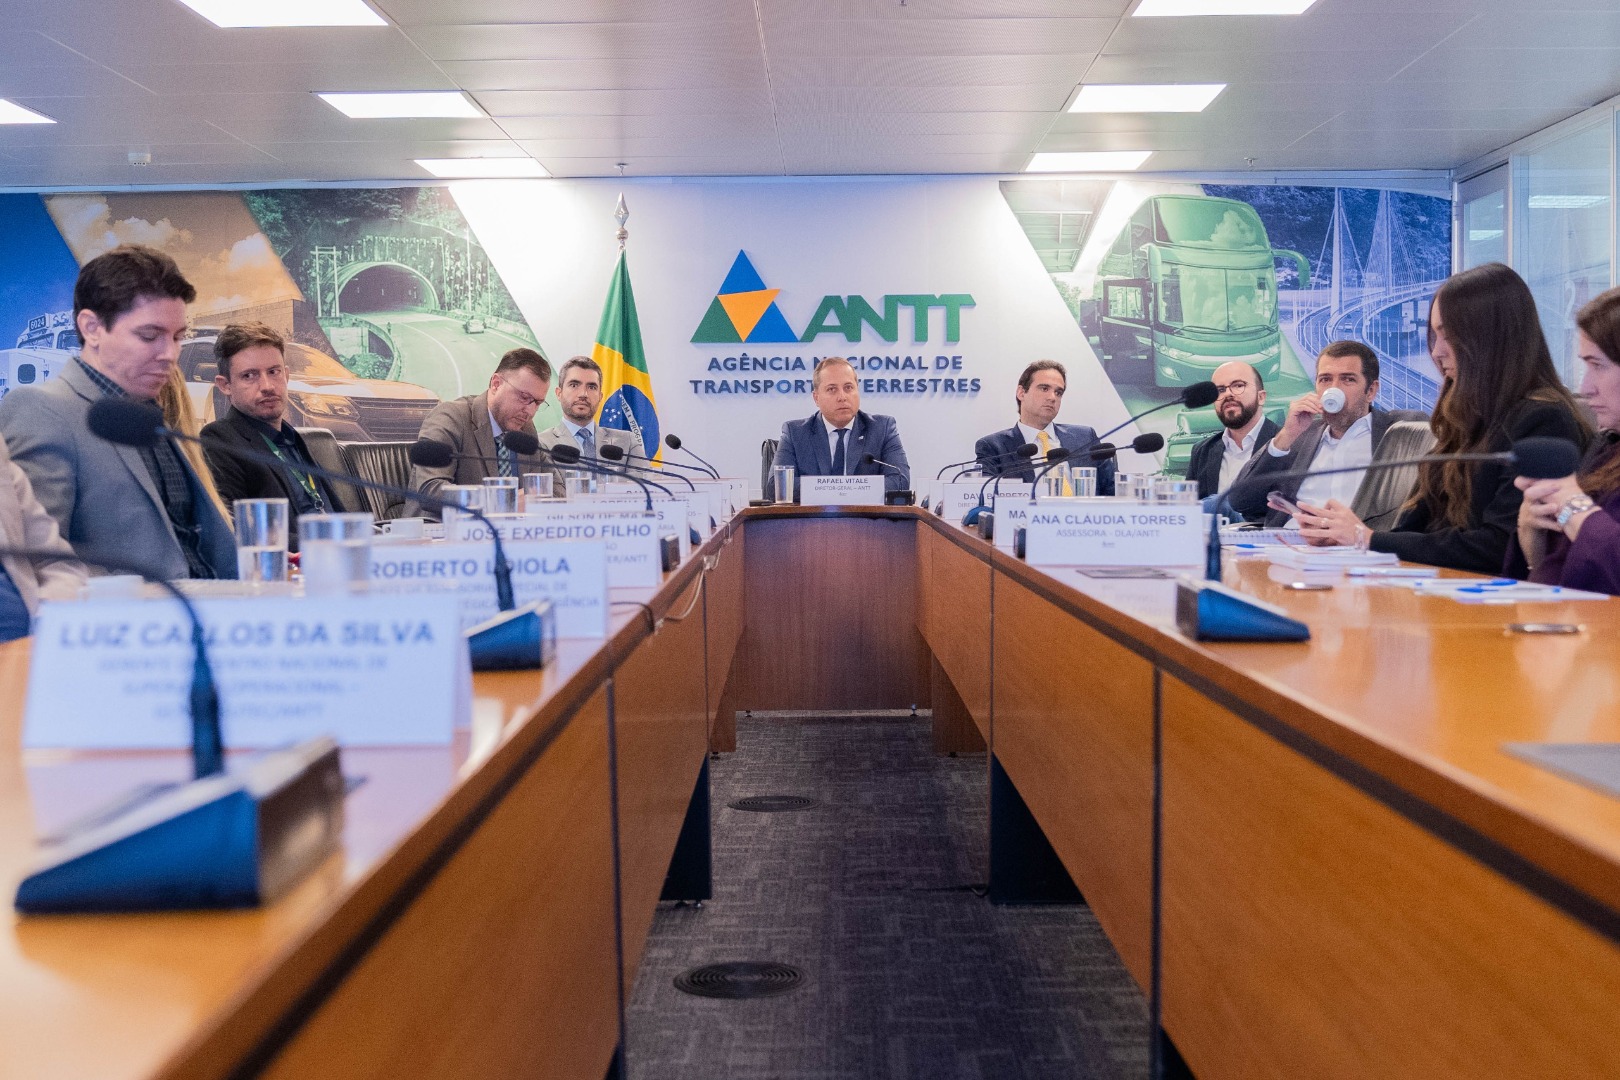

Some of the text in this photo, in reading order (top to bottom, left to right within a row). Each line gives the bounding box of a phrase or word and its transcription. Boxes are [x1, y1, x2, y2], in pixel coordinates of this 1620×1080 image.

[800, 294, 977, 343] ANTT
[708, 353, 963, 371] AGÊNCIA NCIONAL DE
[689, 378, 982, 395] TRANSPORT ERRESTRES
[1031, 514, 1061, 525] ANA
[1131, 514, 1187, 525] TORRES
[512, 525, 596, 540] EXPEDITO
[601, 524, 651, 537] FILHO
[1056, 529, 1107, 537] ASSESSORA
[372, 559, 478, 578] ROBERTO
[60, 619, 435, 650] LUIZ CALOS DA SILVA
